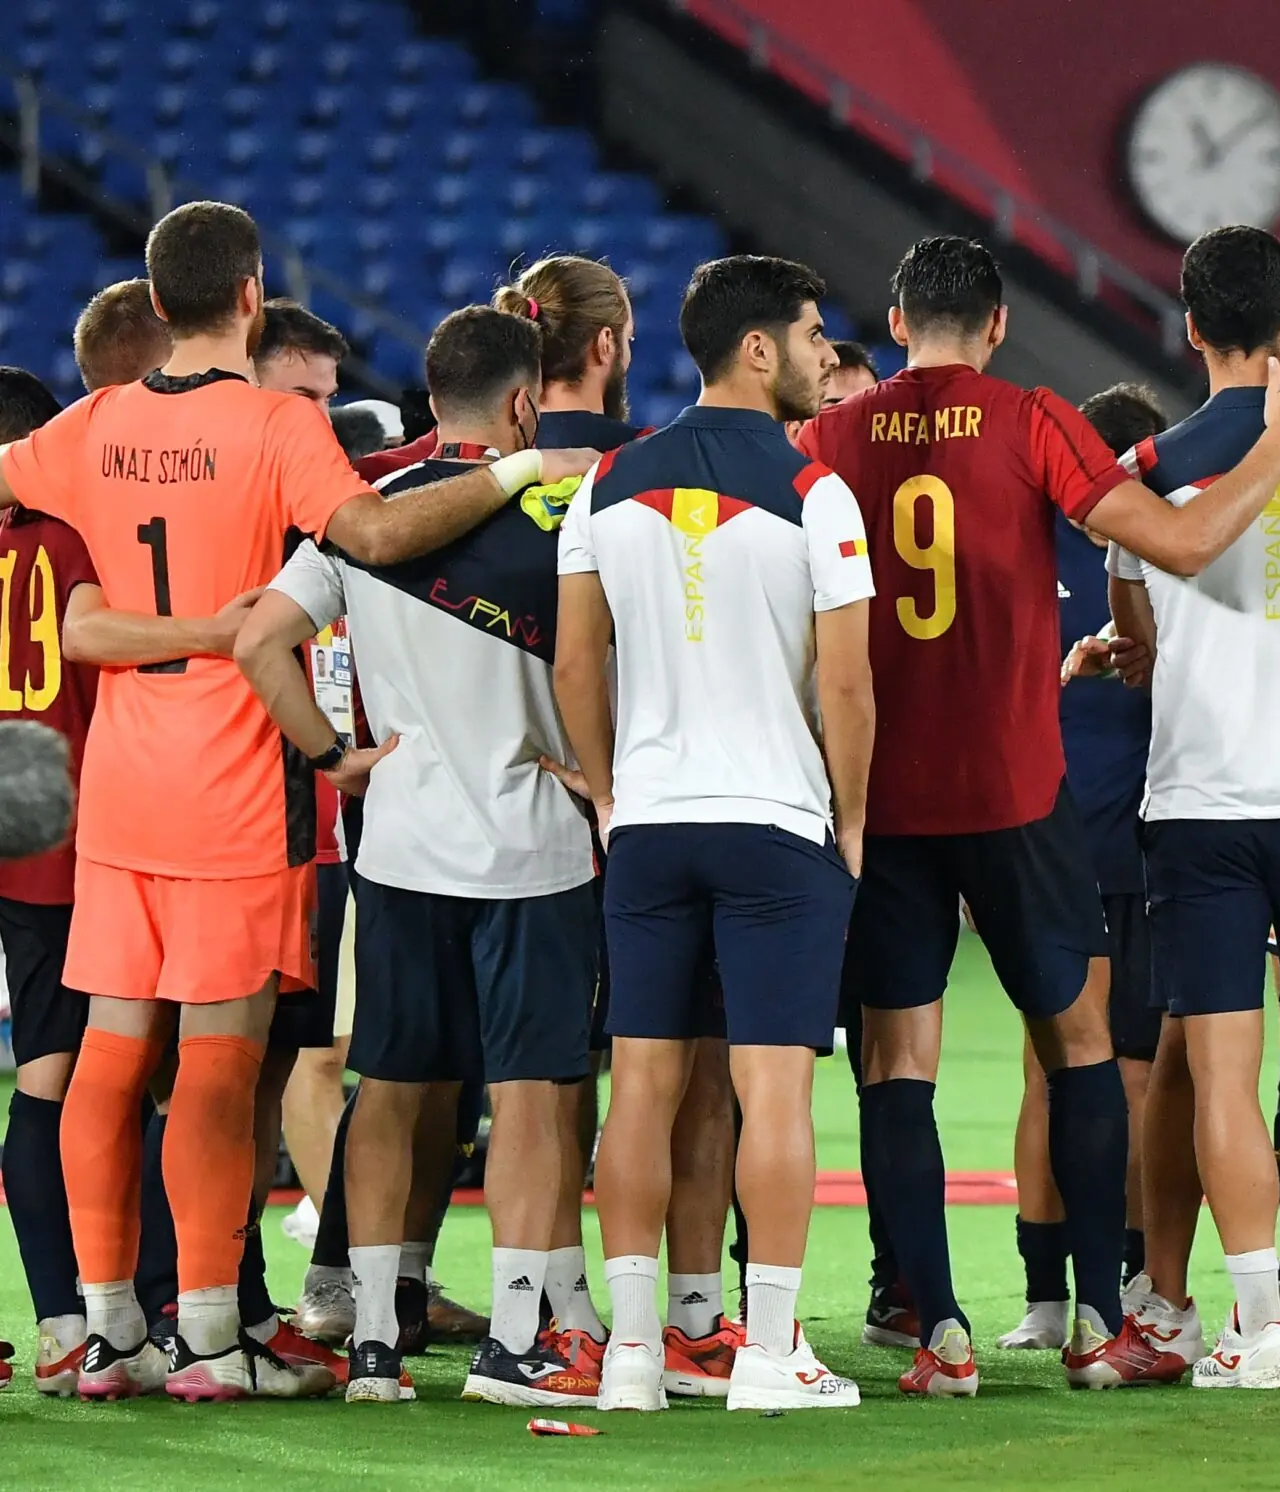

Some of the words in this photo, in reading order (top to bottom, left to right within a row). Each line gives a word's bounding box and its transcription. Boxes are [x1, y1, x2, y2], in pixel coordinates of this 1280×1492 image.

[102, 443, 152, 482] UNAI
[158, 438, 216, 484] SIMÓN
[871, 411, 929, 445] RAFA
[935, 406, 982, 442] MIR
[137, 517, 189, 674] 1
[684, 504, 706, 642] ESPAÑA
[893, 474, 957, 640] 9
[429, 577, 543, 647] ESPAÑ
